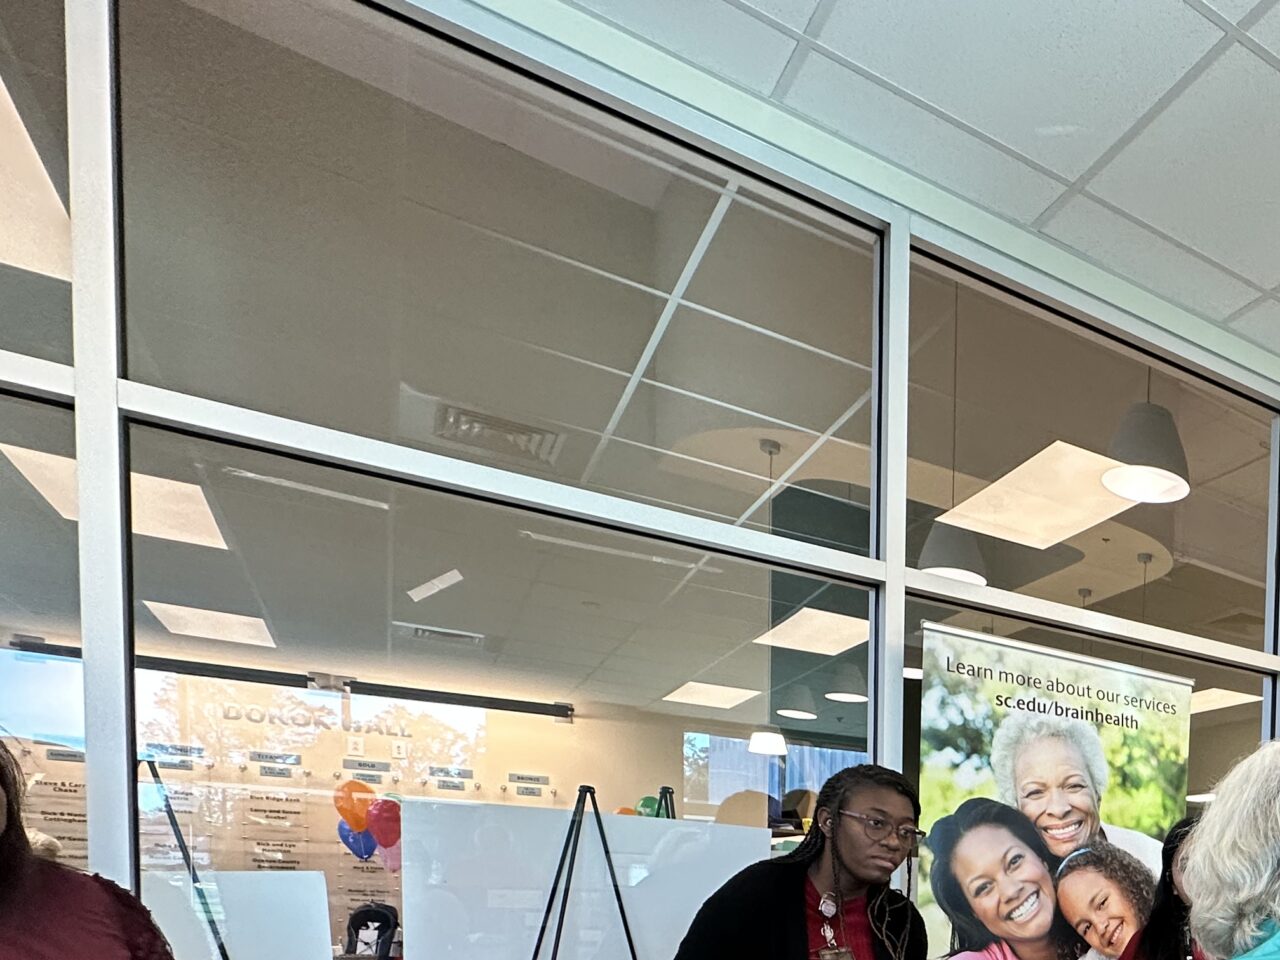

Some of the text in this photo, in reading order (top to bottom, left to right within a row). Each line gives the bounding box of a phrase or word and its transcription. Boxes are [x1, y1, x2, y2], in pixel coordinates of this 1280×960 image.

[946, 657, 1177, 715] Learn more about our services
[995, 694, 1139, 730] sc.edu/brainhealth
